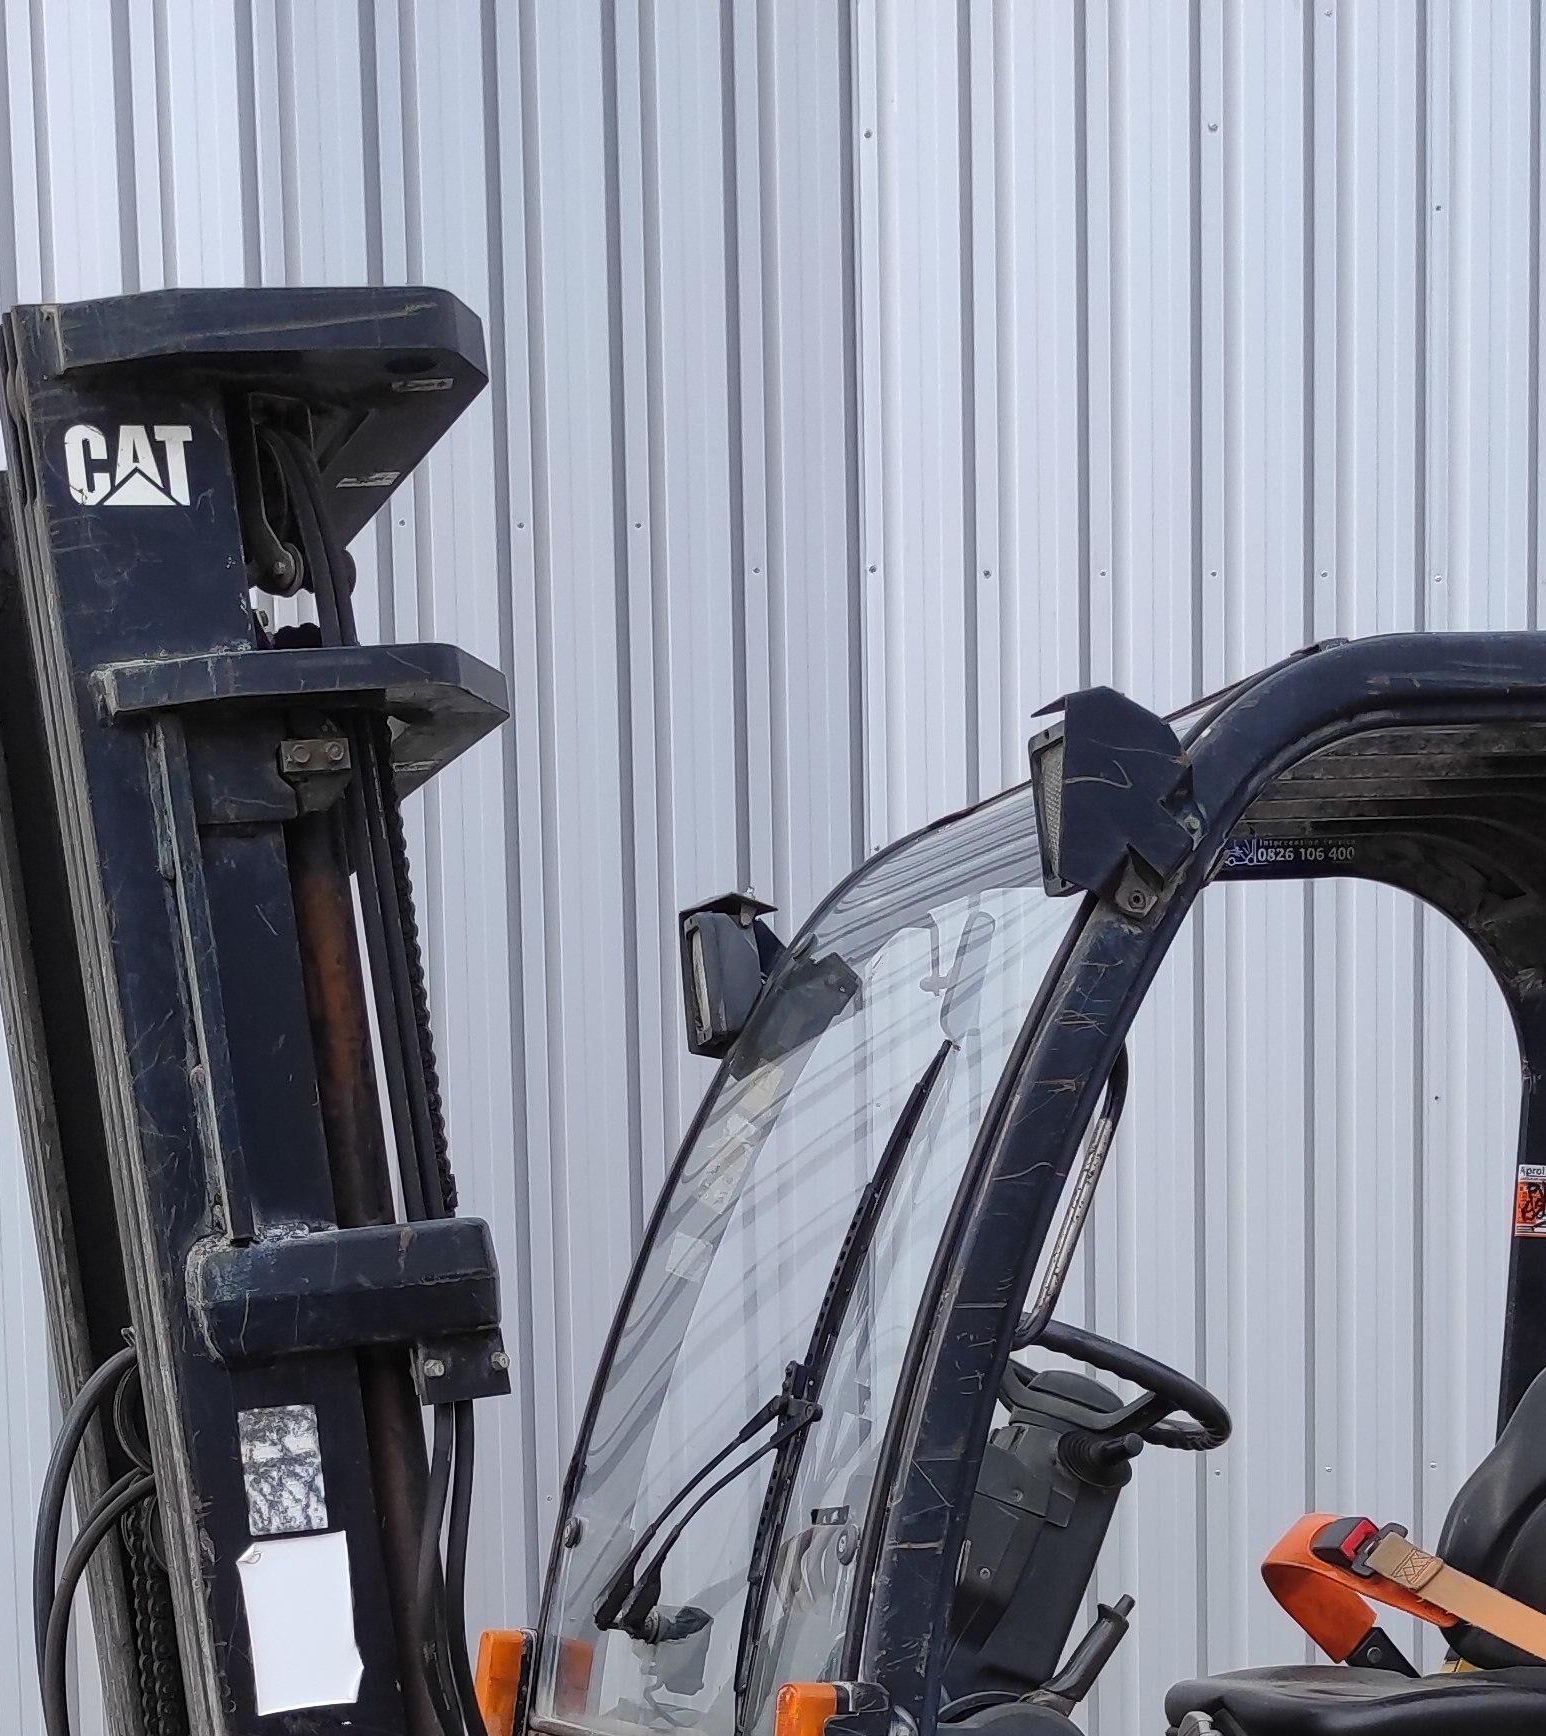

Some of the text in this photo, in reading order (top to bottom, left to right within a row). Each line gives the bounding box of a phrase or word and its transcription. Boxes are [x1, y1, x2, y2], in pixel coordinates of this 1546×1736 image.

[64, 424, 193, 507] CAT
[1257, 846, 1356, 862] 0826 106 400
